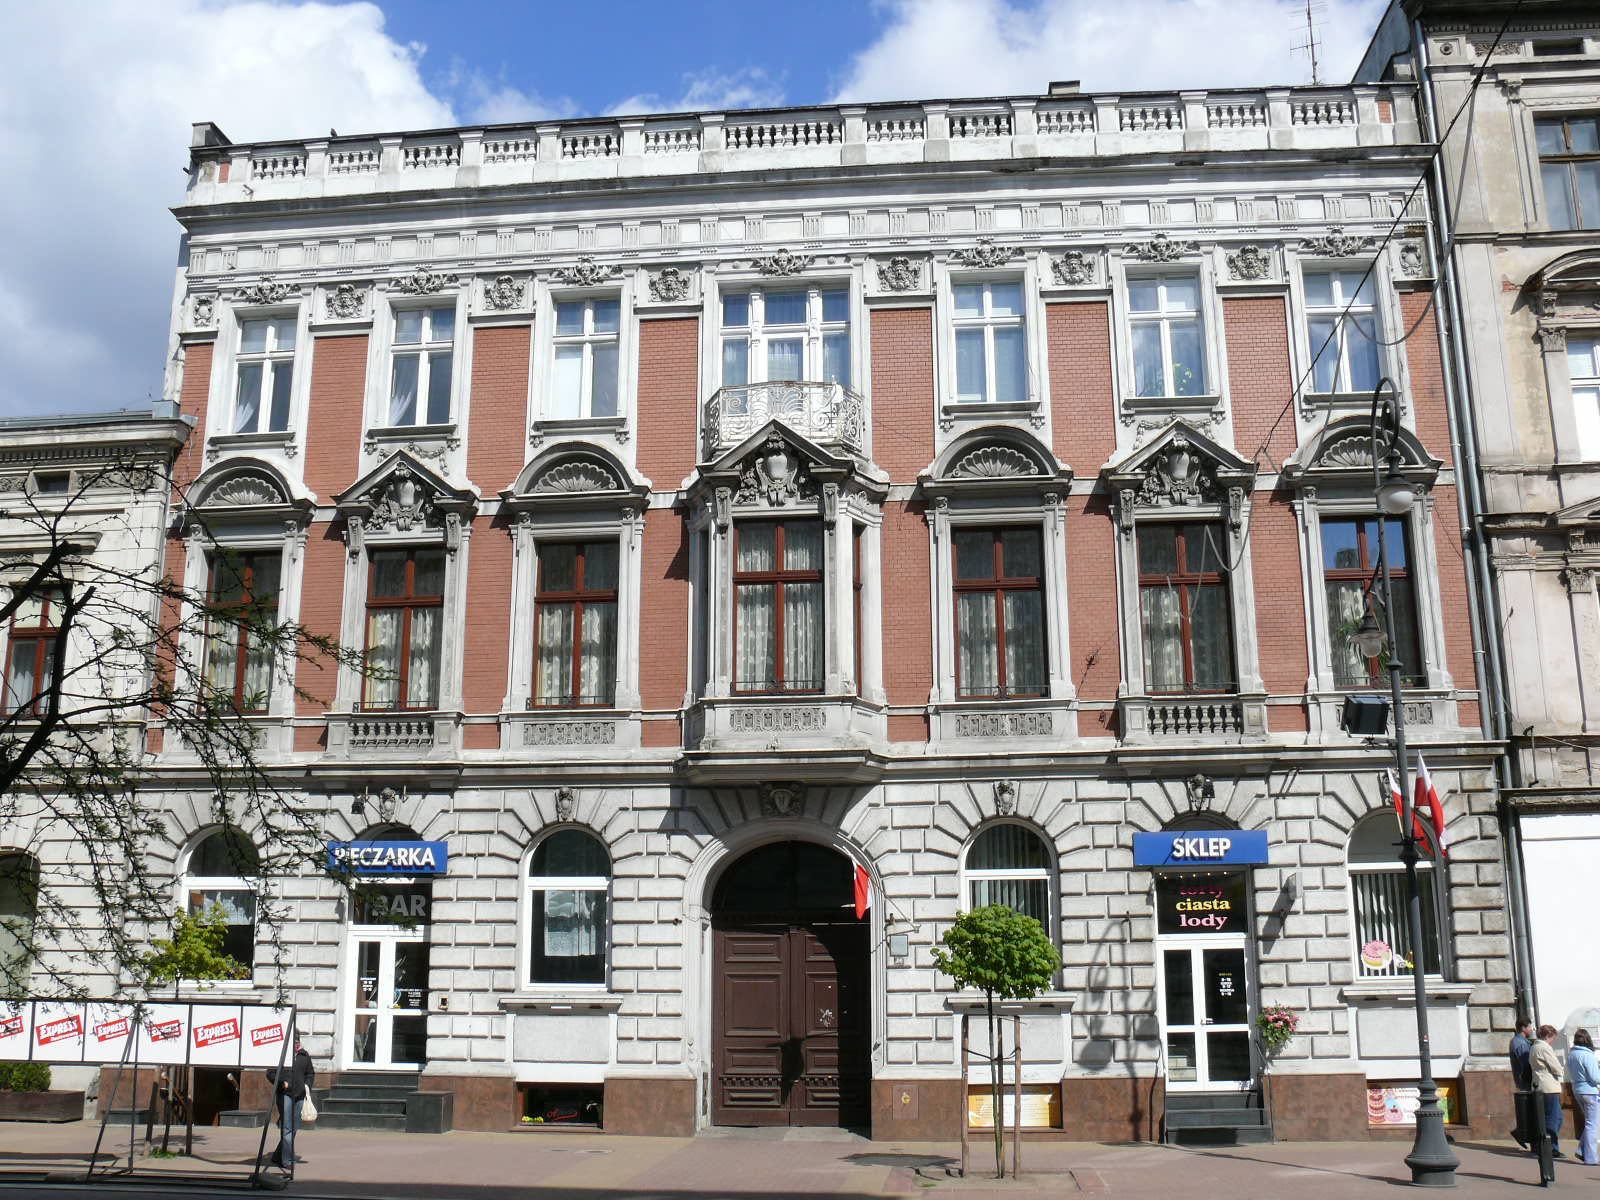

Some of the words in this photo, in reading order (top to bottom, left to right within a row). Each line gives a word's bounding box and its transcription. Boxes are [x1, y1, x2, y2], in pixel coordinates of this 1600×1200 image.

[1172, 837, 1231, 858] SKLEP
[1175, 898, 1231, 912] ciasta
[1179, 913, 1228, 930] lody
